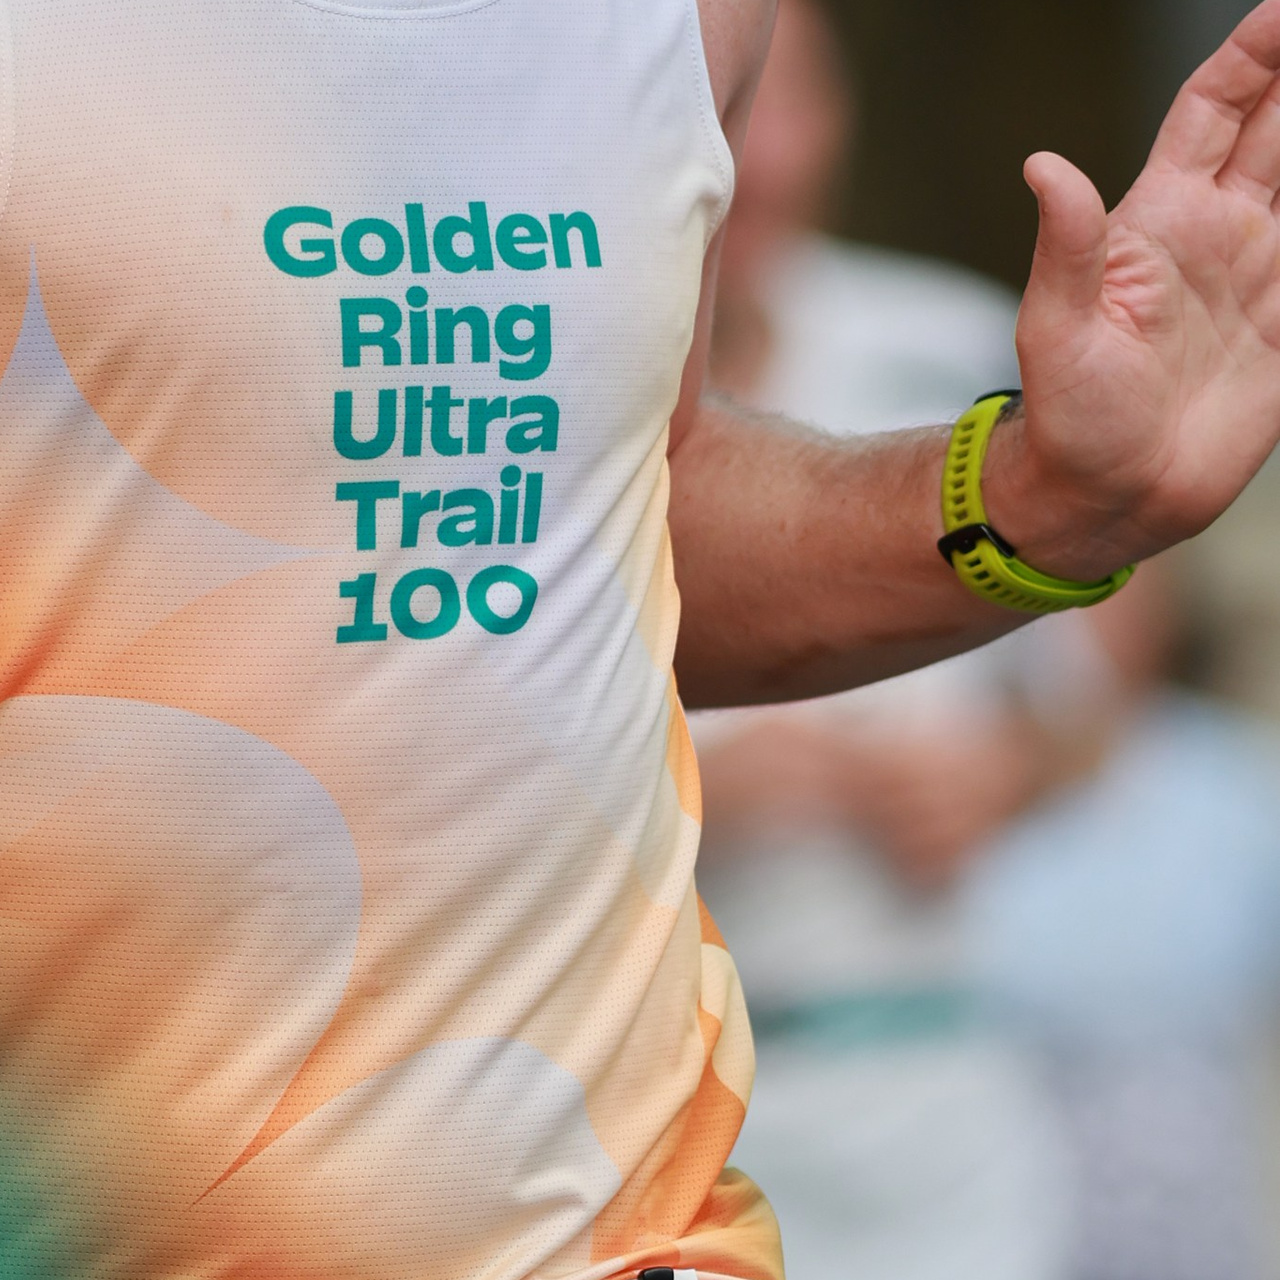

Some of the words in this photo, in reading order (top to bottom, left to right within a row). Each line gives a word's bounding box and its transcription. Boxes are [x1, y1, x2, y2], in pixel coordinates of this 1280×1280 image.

[263, 201, 602, 277] Golden
[340, 286, 552, 381] Ring
[333, 386, 560, 460] Ultra
[336, 465, 543, 551] Trail
[336, 565, 538, 643] 100
